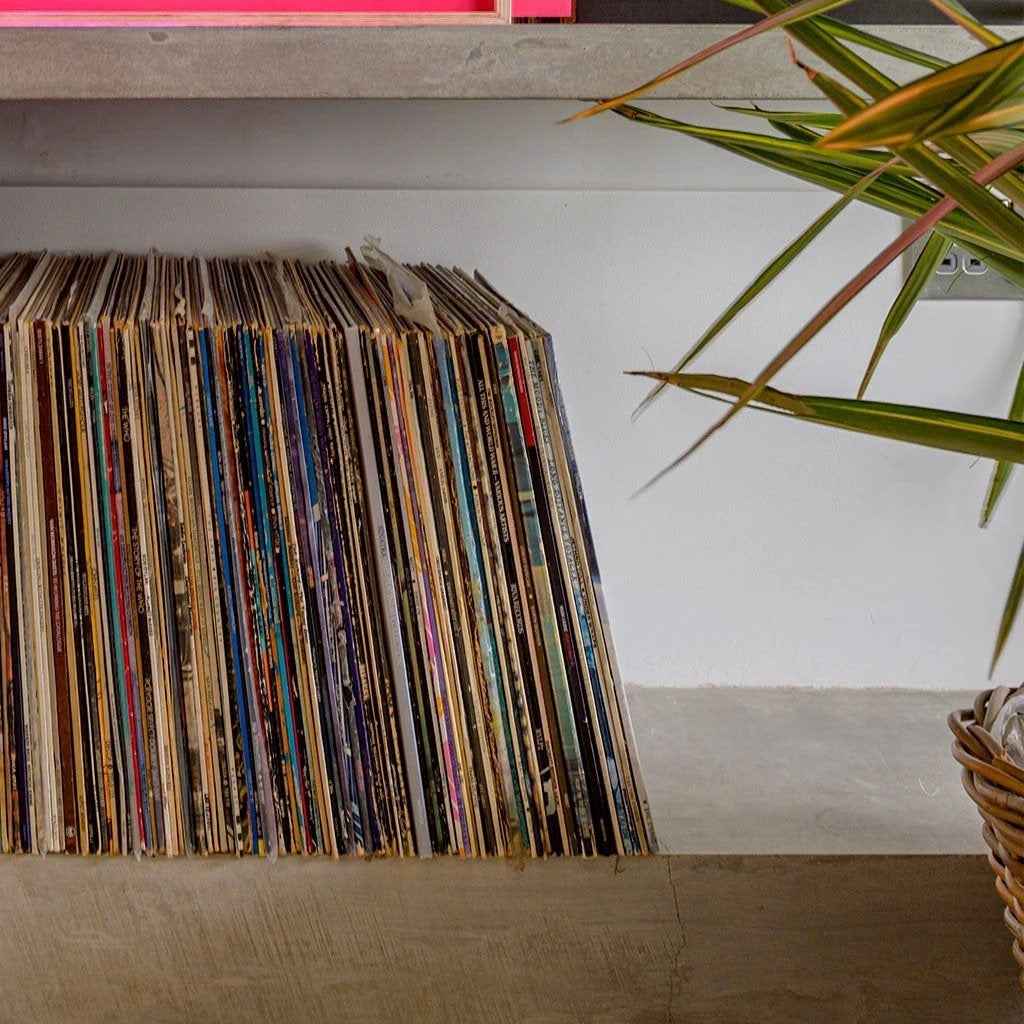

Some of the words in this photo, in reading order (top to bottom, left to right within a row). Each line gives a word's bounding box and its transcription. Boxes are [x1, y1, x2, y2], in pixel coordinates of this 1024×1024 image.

[529, 359, 537, 379] THE
[477, 379, 485, 392] ALL
[532, 381, 542, 415] MOODY
[479, 393, 487, 409] THIS
[482, 410, 490, 426] AND
[538, 417, 548, 444] BLUES
[485, 427, 494, 452] WORLD
[489, 453, 497, 469] WAR
[545, 459, 555, 486] LONG
[494, 481, 505, 512] VARIOUS
[551, 488, 566, 534] DISTANCE
[377, 526, 387, 559] SINATRA
[498, 514, 510, 544] ARTISTS
[133, 542, 141, 565] STORY
[561, 536, 577, 582] VOYAGER
[135, 567, 141, 578] OF
[512, 599, 523, 635] RECORDS
[144, 678, 153, 712] POLYDOR
